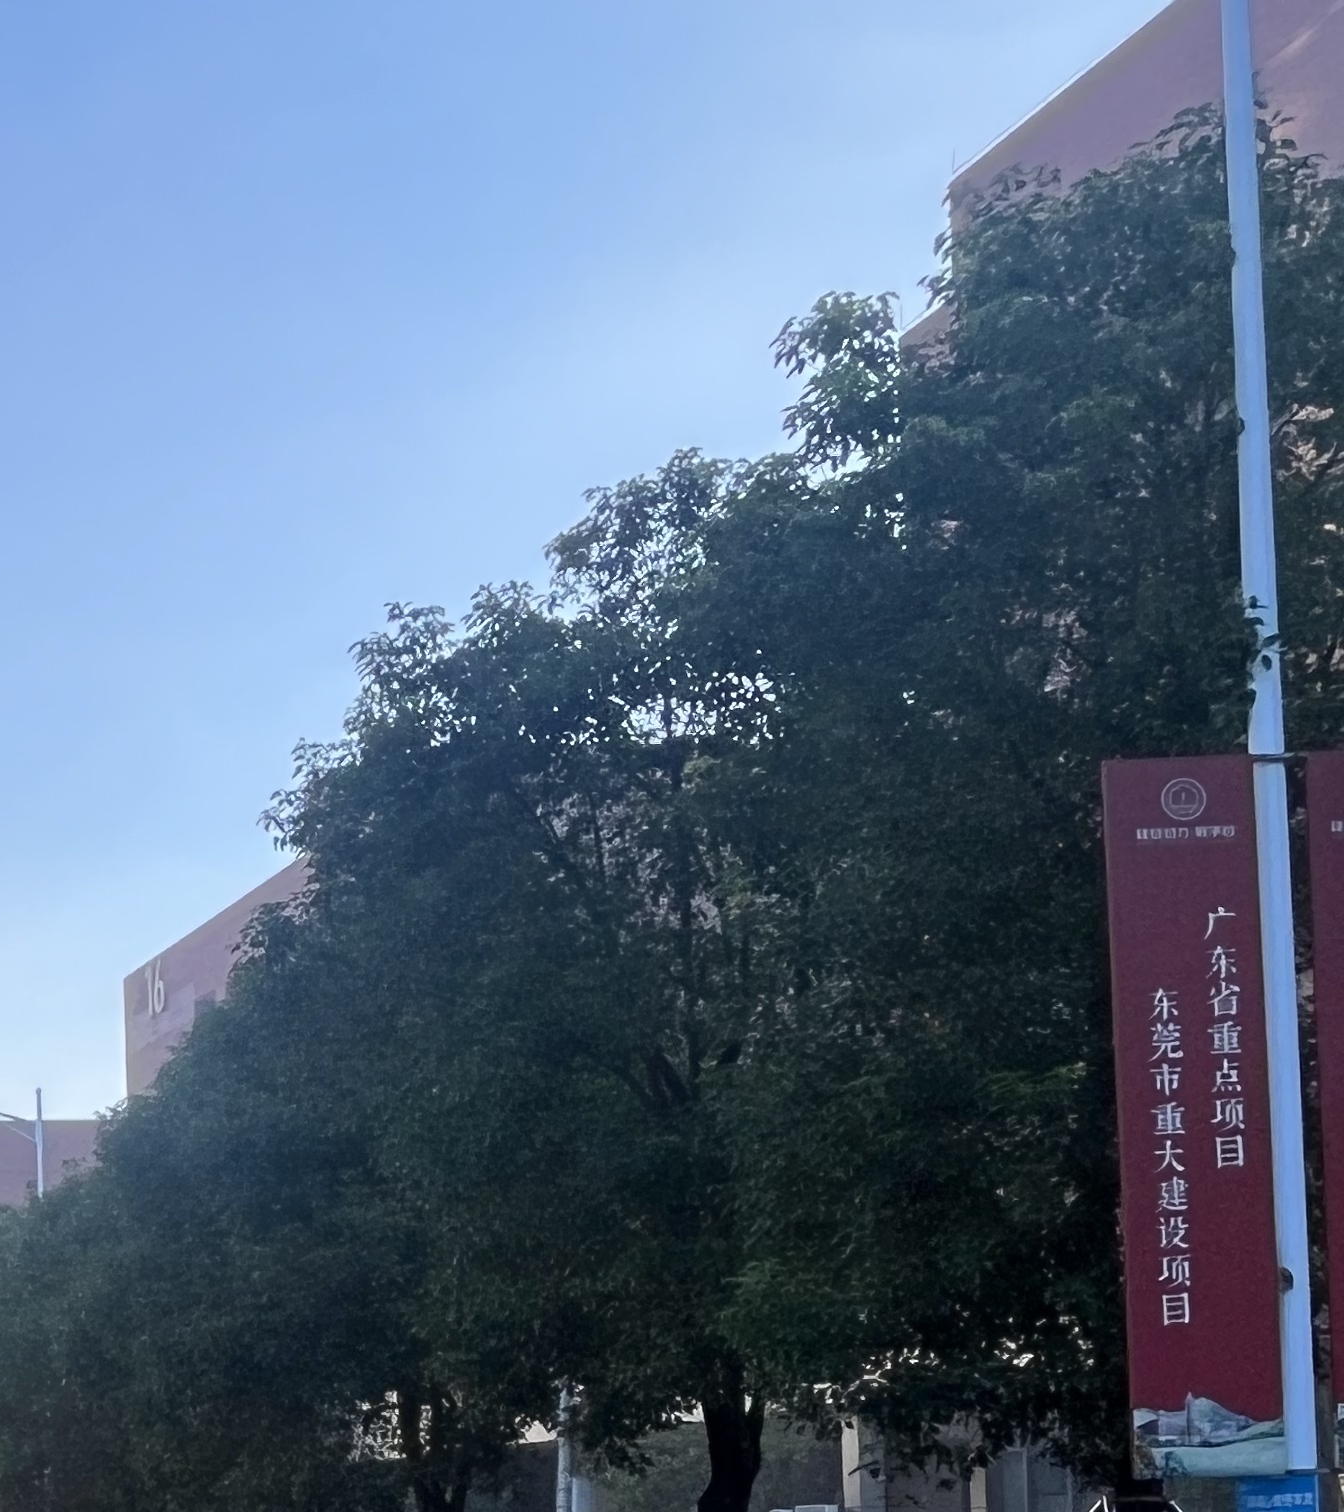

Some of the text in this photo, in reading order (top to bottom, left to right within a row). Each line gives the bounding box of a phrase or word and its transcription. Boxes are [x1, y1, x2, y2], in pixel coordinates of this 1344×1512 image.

[1147, 987, 1192, 1327] 东莞市重大建设项目
[1204, 906, 1246, 1169] 广东省重点项目
